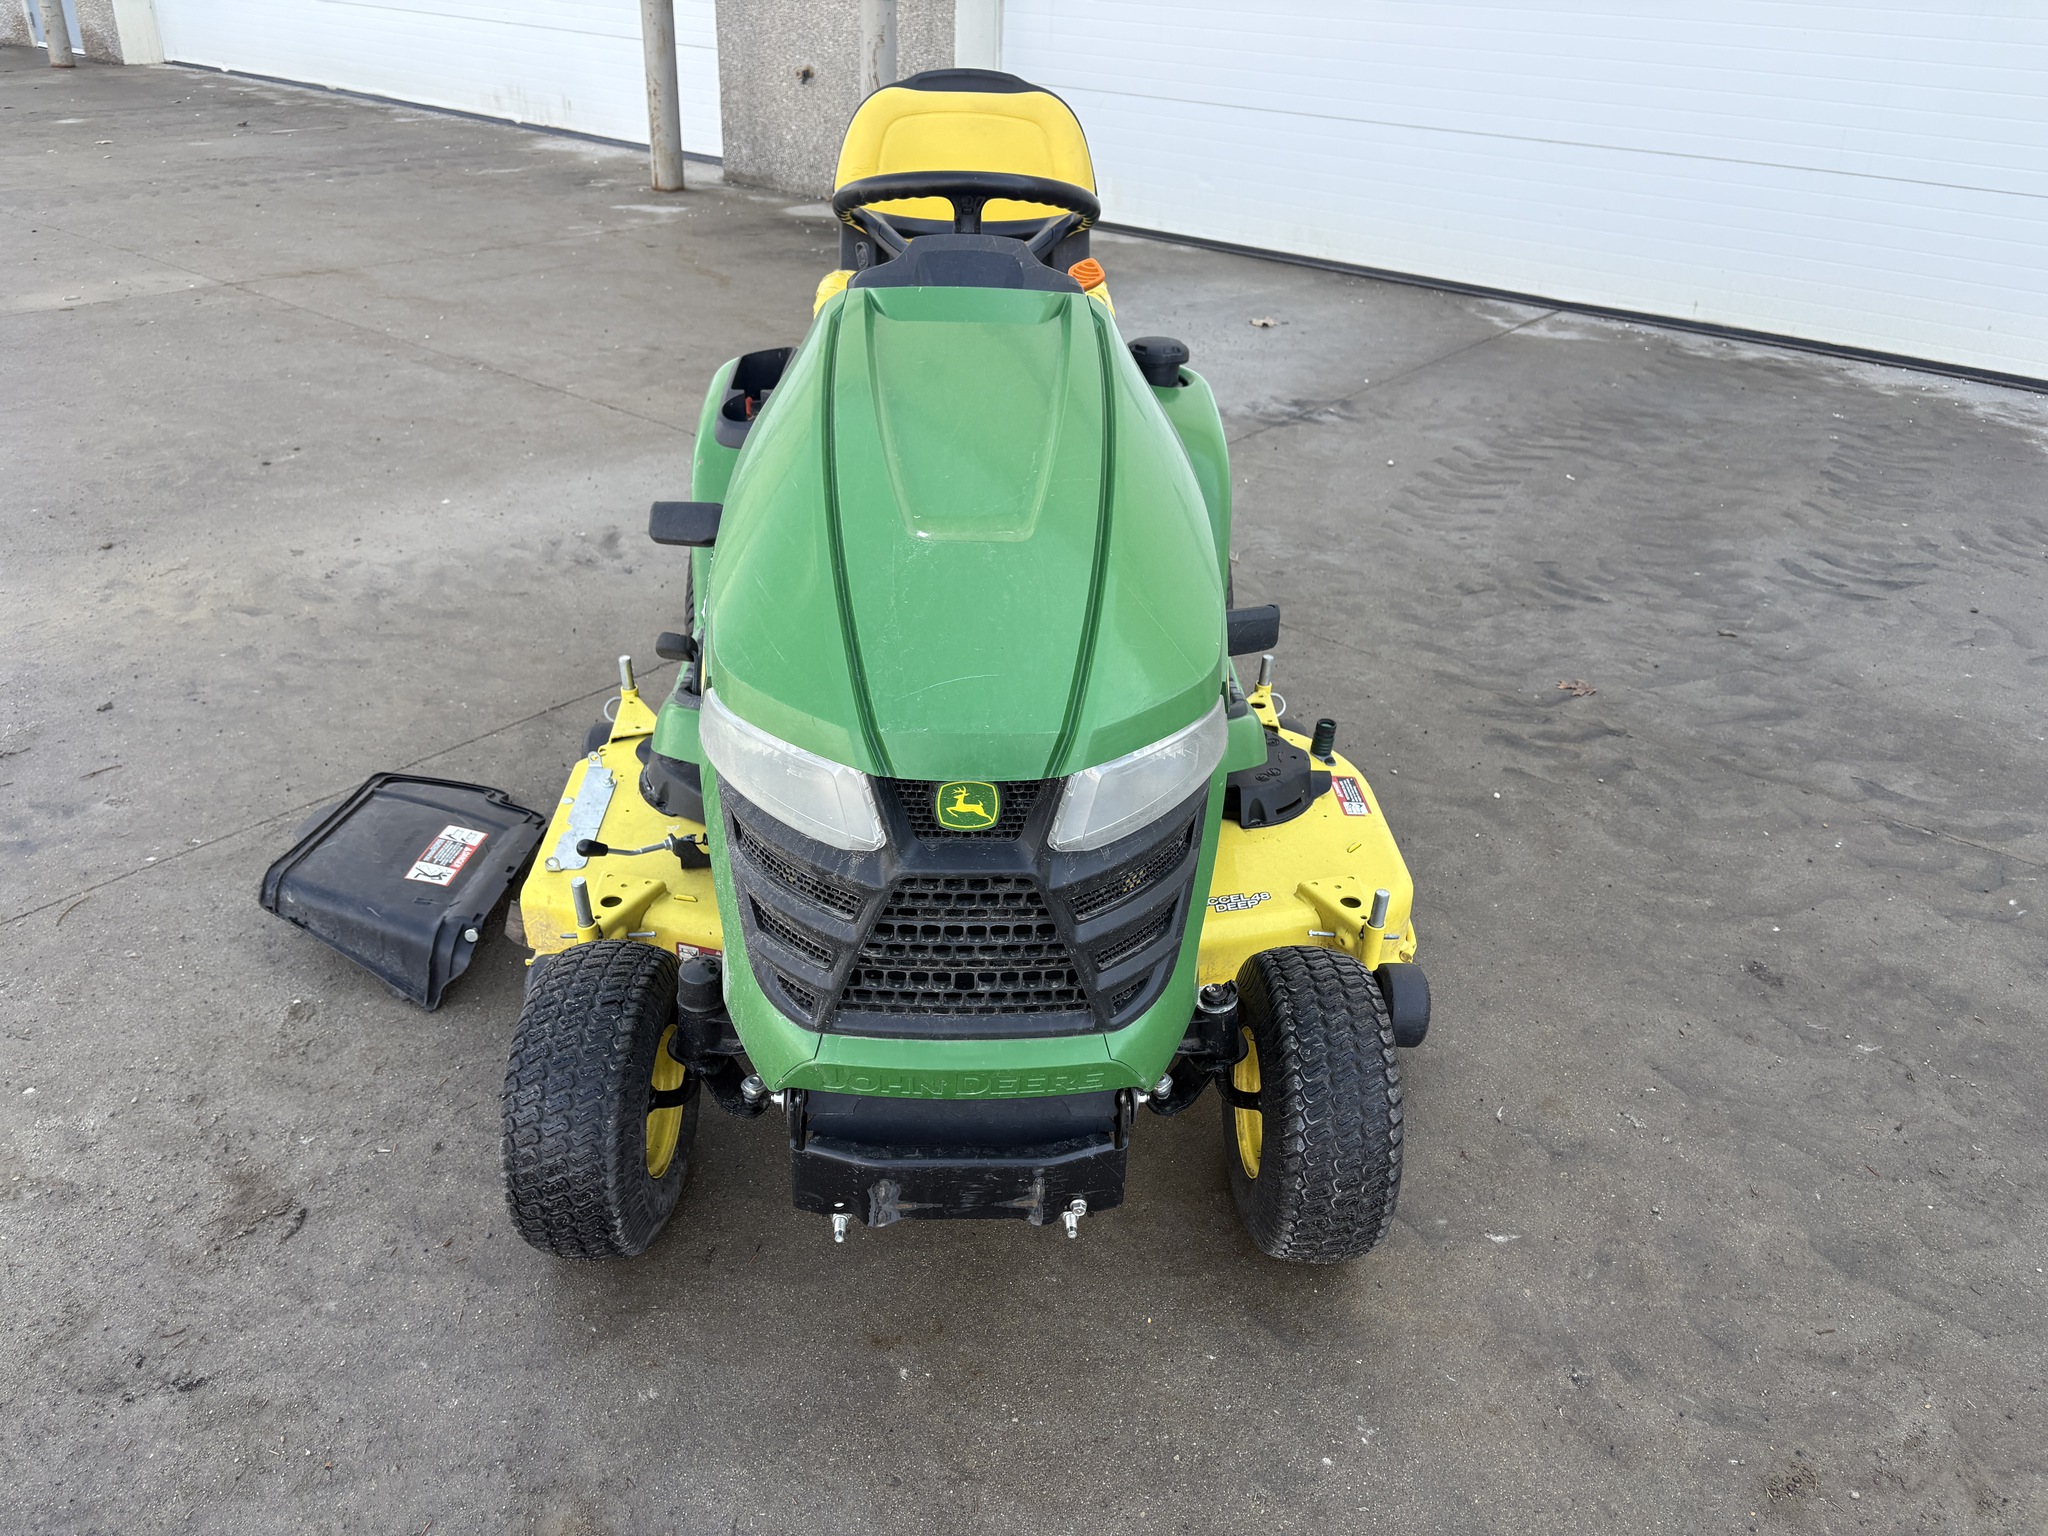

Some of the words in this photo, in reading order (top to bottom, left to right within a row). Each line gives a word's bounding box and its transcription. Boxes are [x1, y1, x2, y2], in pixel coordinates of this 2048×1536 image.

[1207, 893, 1251, 906] CCEL
[1215, 900, 1260, 913] DEEP
[822, 1067, 944, 1096] JOHN
[956, 1071, 1105, 1096] DEERE
